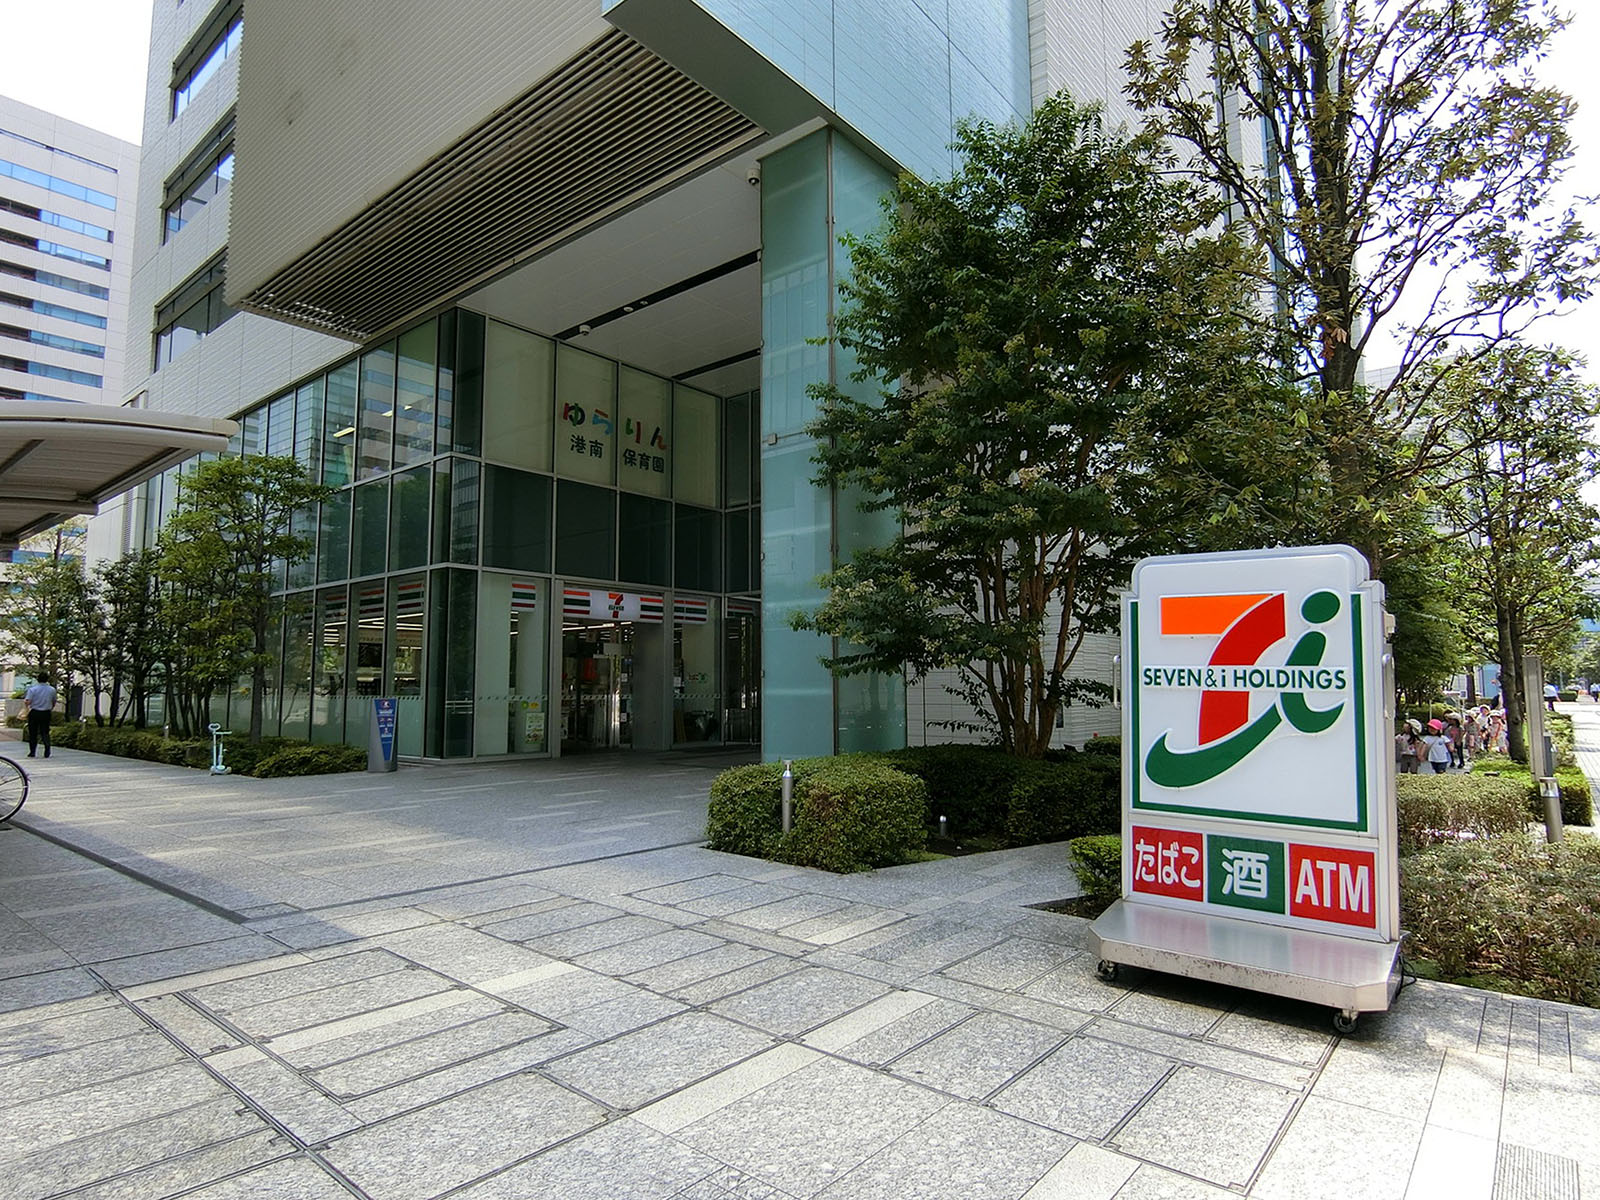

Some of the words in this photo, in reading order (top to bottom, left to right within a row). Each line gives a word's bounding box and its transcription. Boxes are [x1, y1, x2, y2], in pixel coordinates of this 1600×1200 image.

[562, 402, 667, 450] ゆらりん
[570, 434, 604, 459] 港南
[622, 448, 665, 474] 保育園
[1233, 668, 1347, 690] HOLDINGS
[1134, 838, 1201, 888] たばこ
[1221, 847, 1270, 899] 酒
[1295, 858, 1370, 914] ATM
